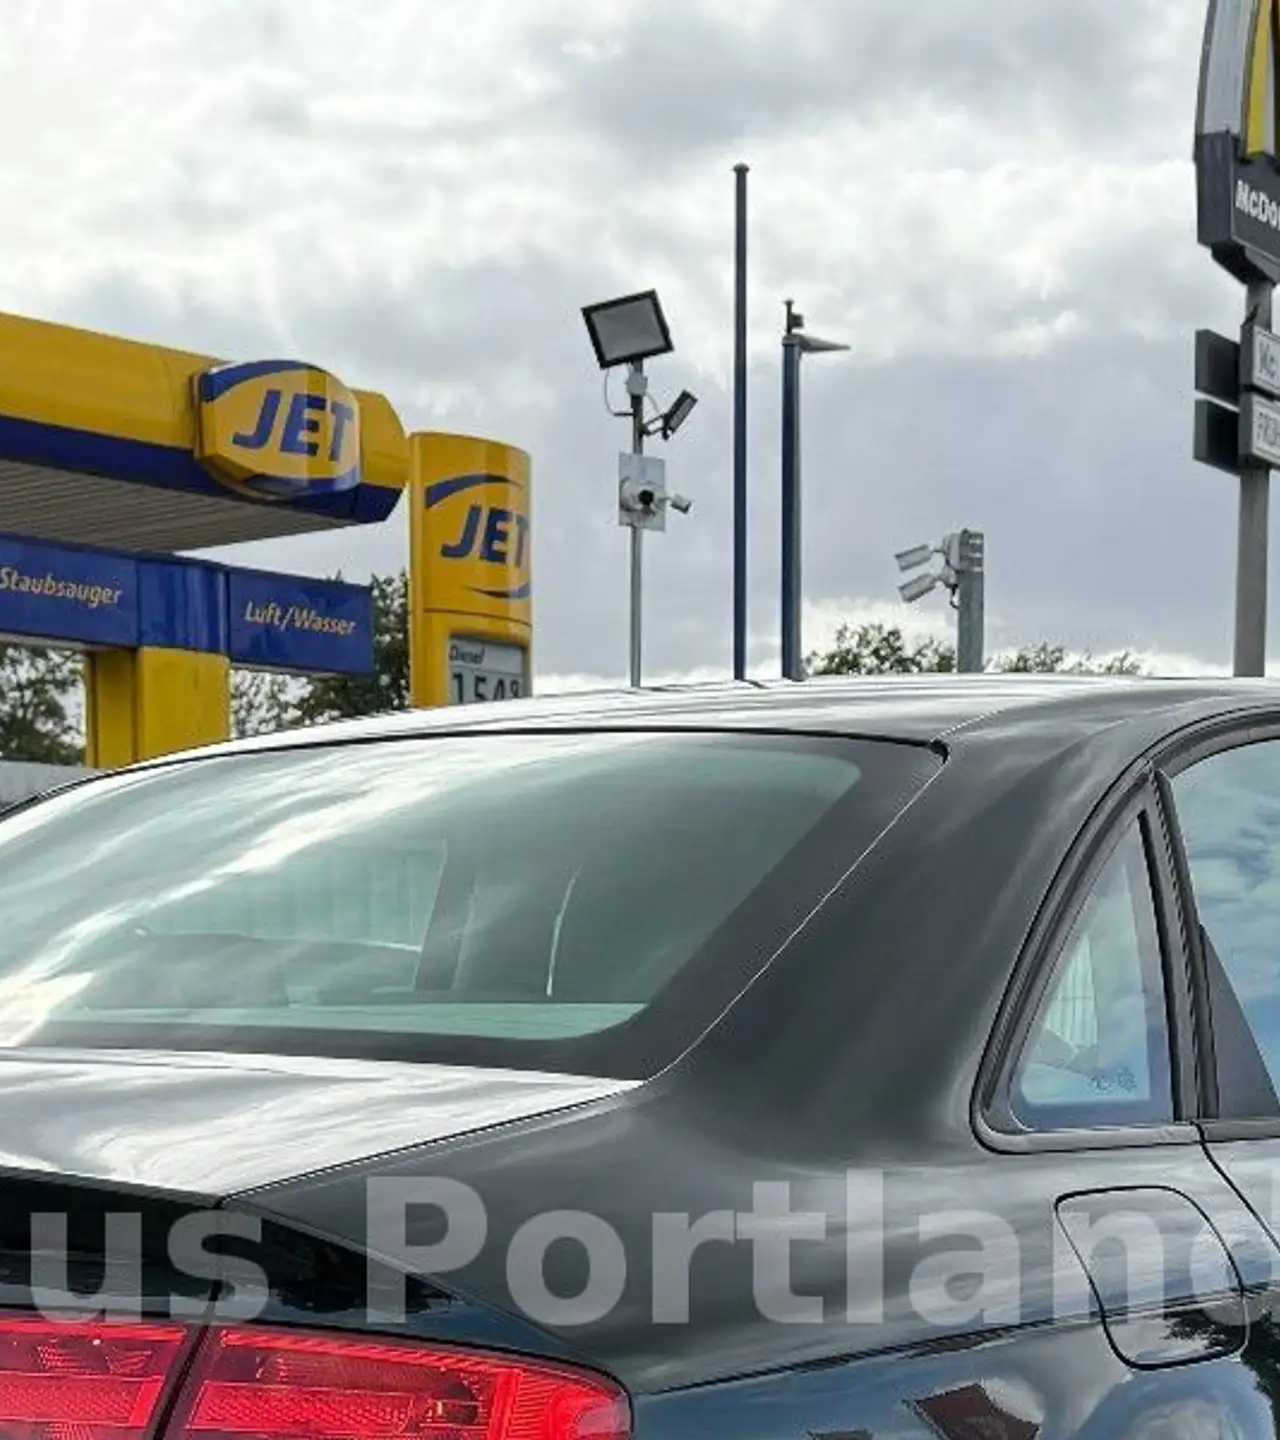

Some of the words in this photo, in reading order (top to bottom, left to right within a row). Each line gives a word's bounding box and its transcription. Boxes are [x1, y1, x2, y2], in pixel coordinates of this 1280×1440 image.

[232, 388, 356, 463] JET
[439, 505, 530, 568] JET
[243, 601, 357, 637] Luft/Wasser
